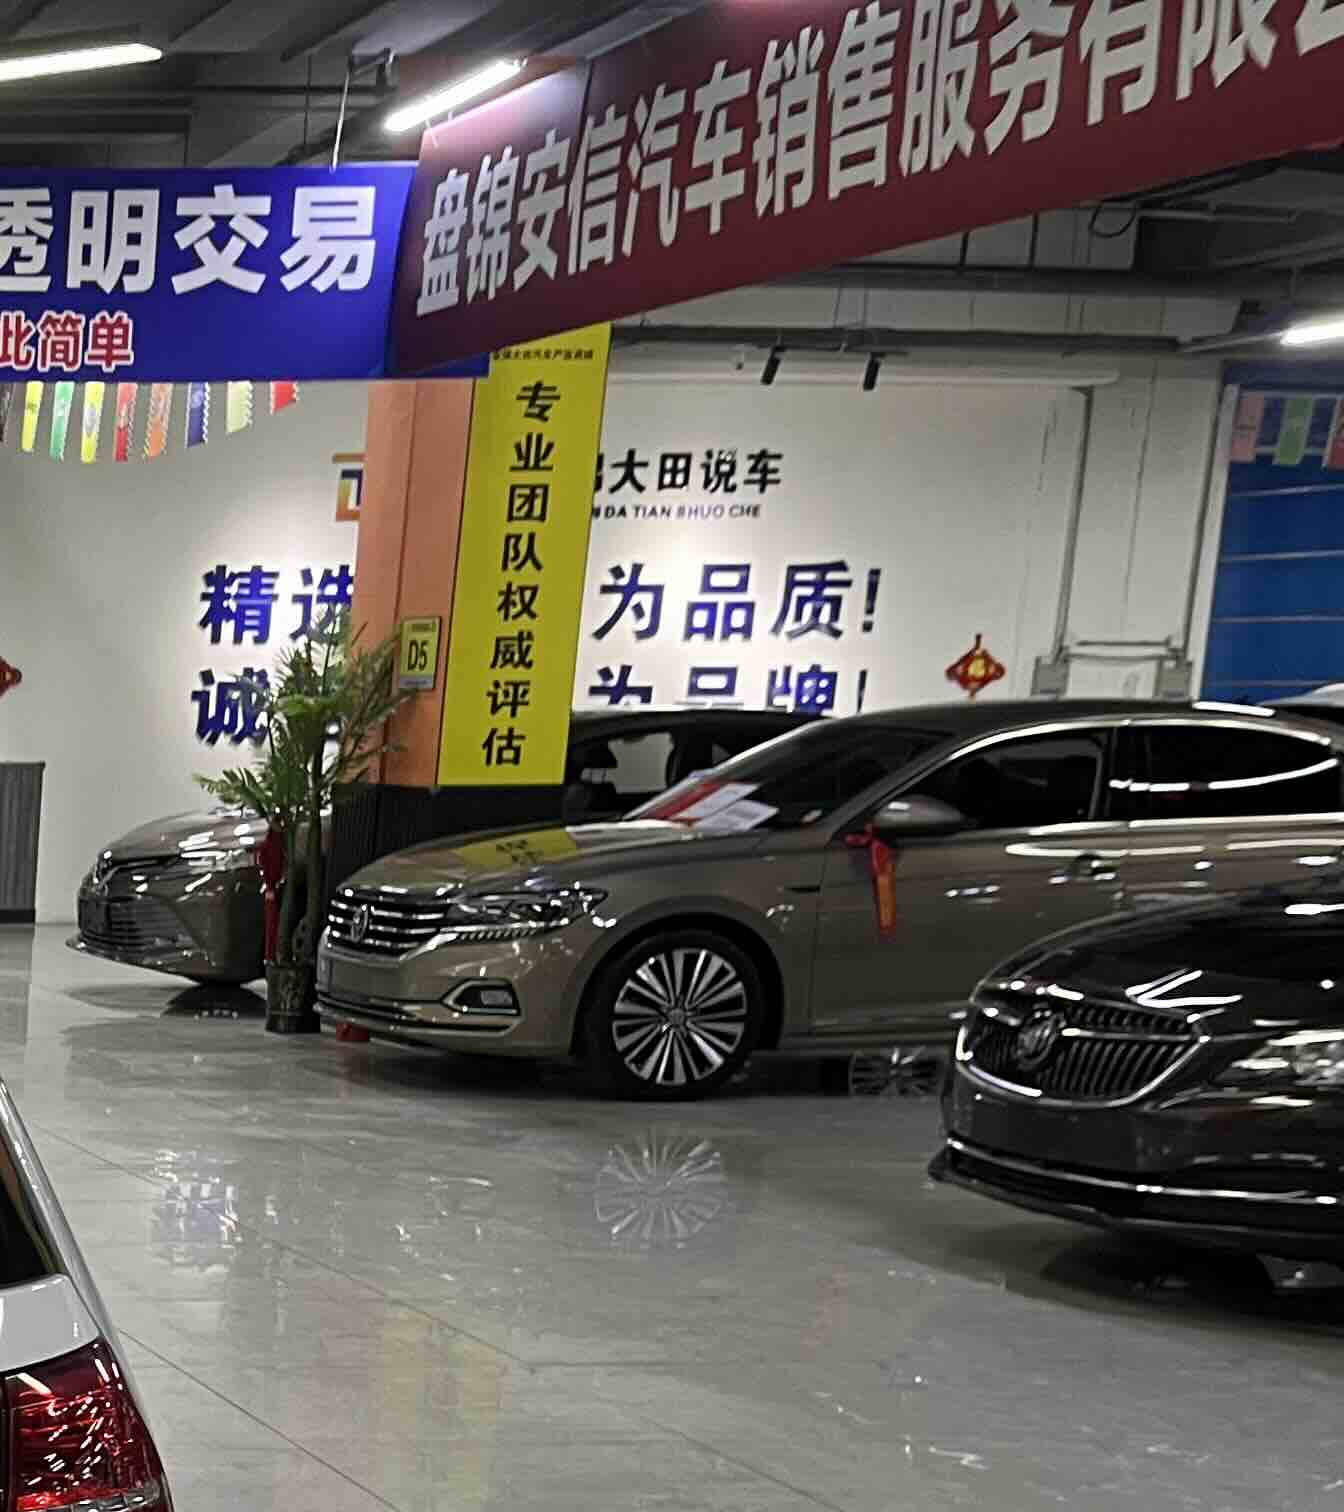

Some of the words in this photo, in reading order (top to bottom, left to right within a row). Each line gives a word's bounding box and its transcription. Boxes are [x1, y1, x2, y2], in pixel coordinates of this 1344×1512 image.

[415, 0, 1344, 317] 盘锦安信汽车销售服务有限
[482, 381, 562, 767] 专业团队权威评估
[604, 505, 627, 519] DA
[633, 504, 671, 518] TIAN
[729, 503, 761, 517] CHE
[408, 639, 428, 672] D5
